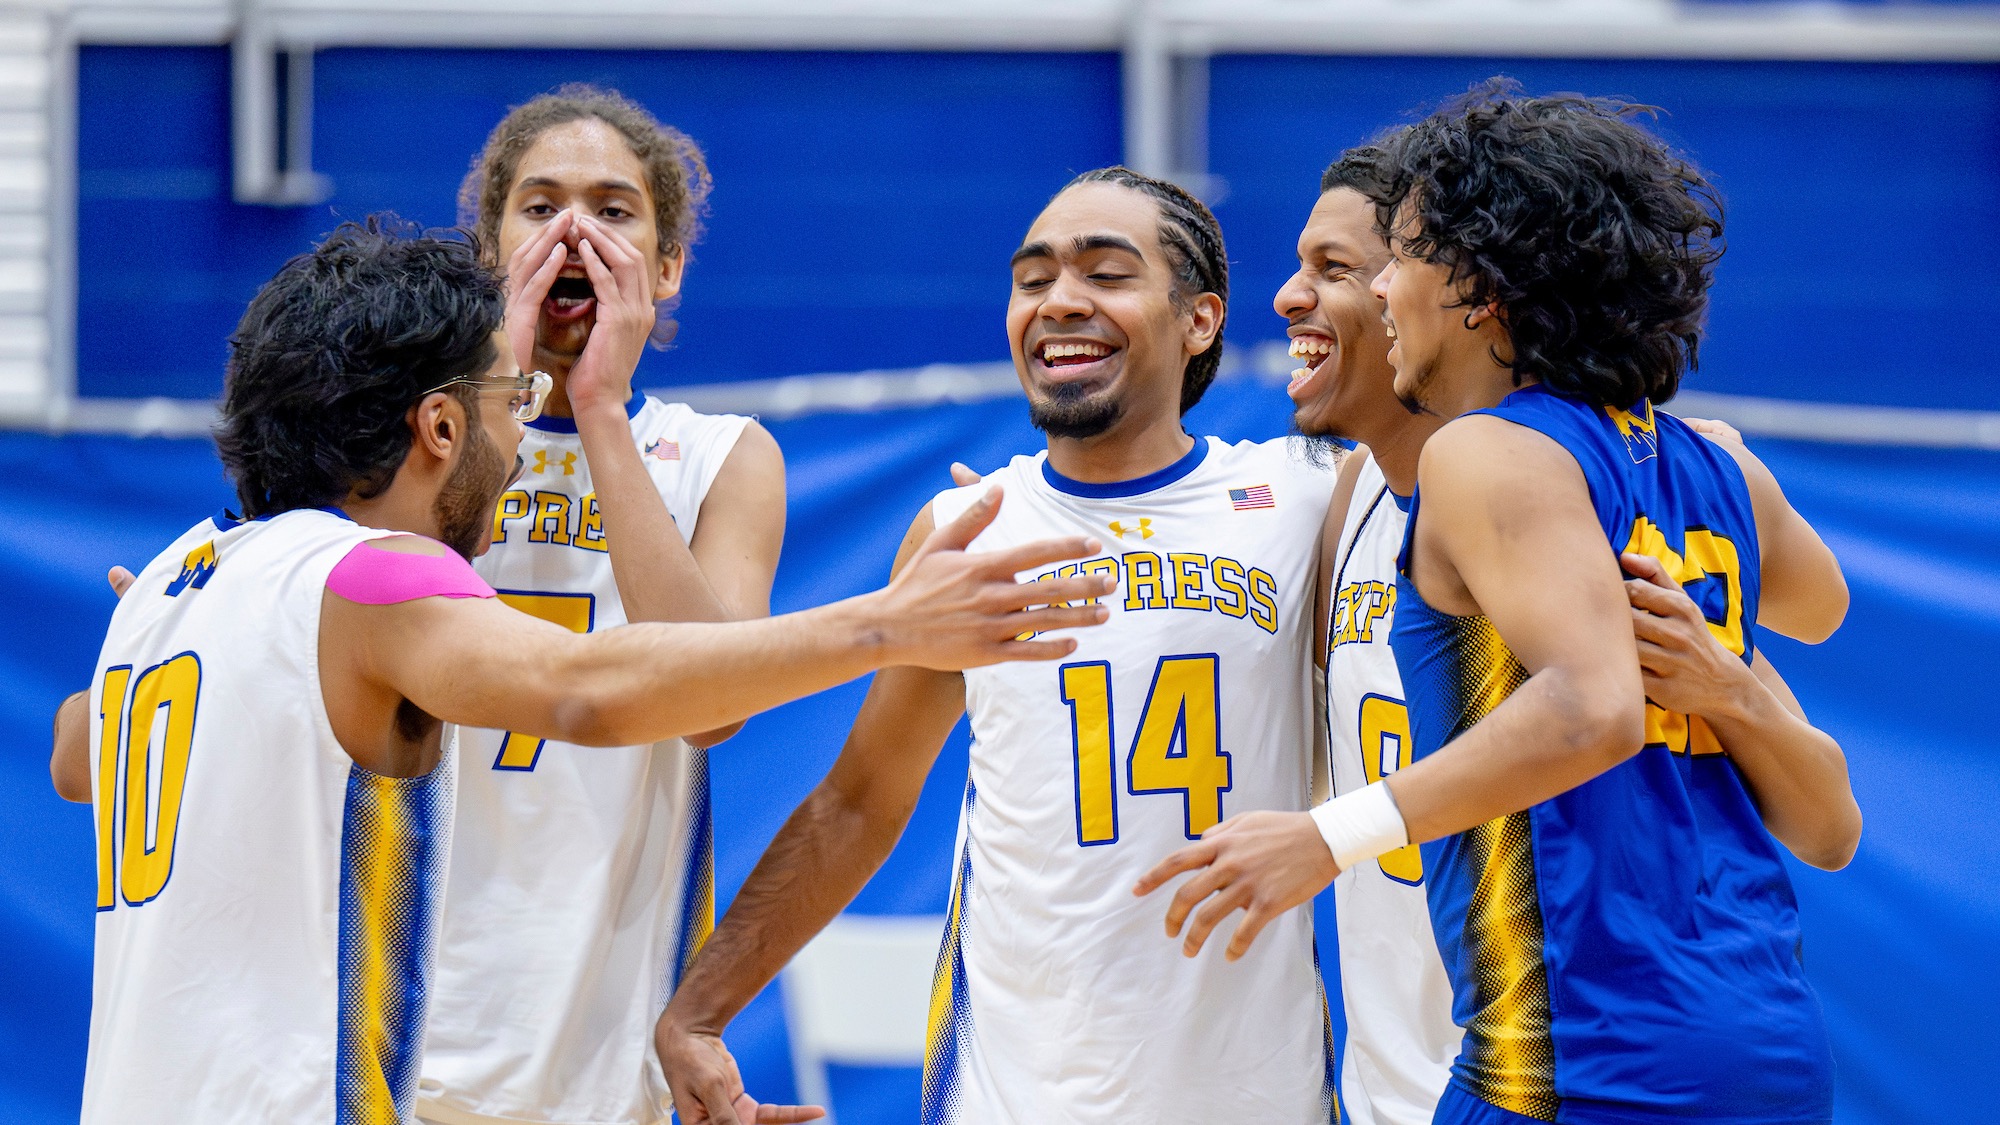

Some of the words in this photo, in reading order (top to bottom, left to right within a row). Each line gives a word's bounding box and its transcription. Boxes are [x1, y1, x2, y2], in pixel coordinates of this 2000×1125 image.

[1014, 551, 1279, 641] PRESS
[97, 650, 202, 911] 10
[1059, 652, 1232, 847] 14
